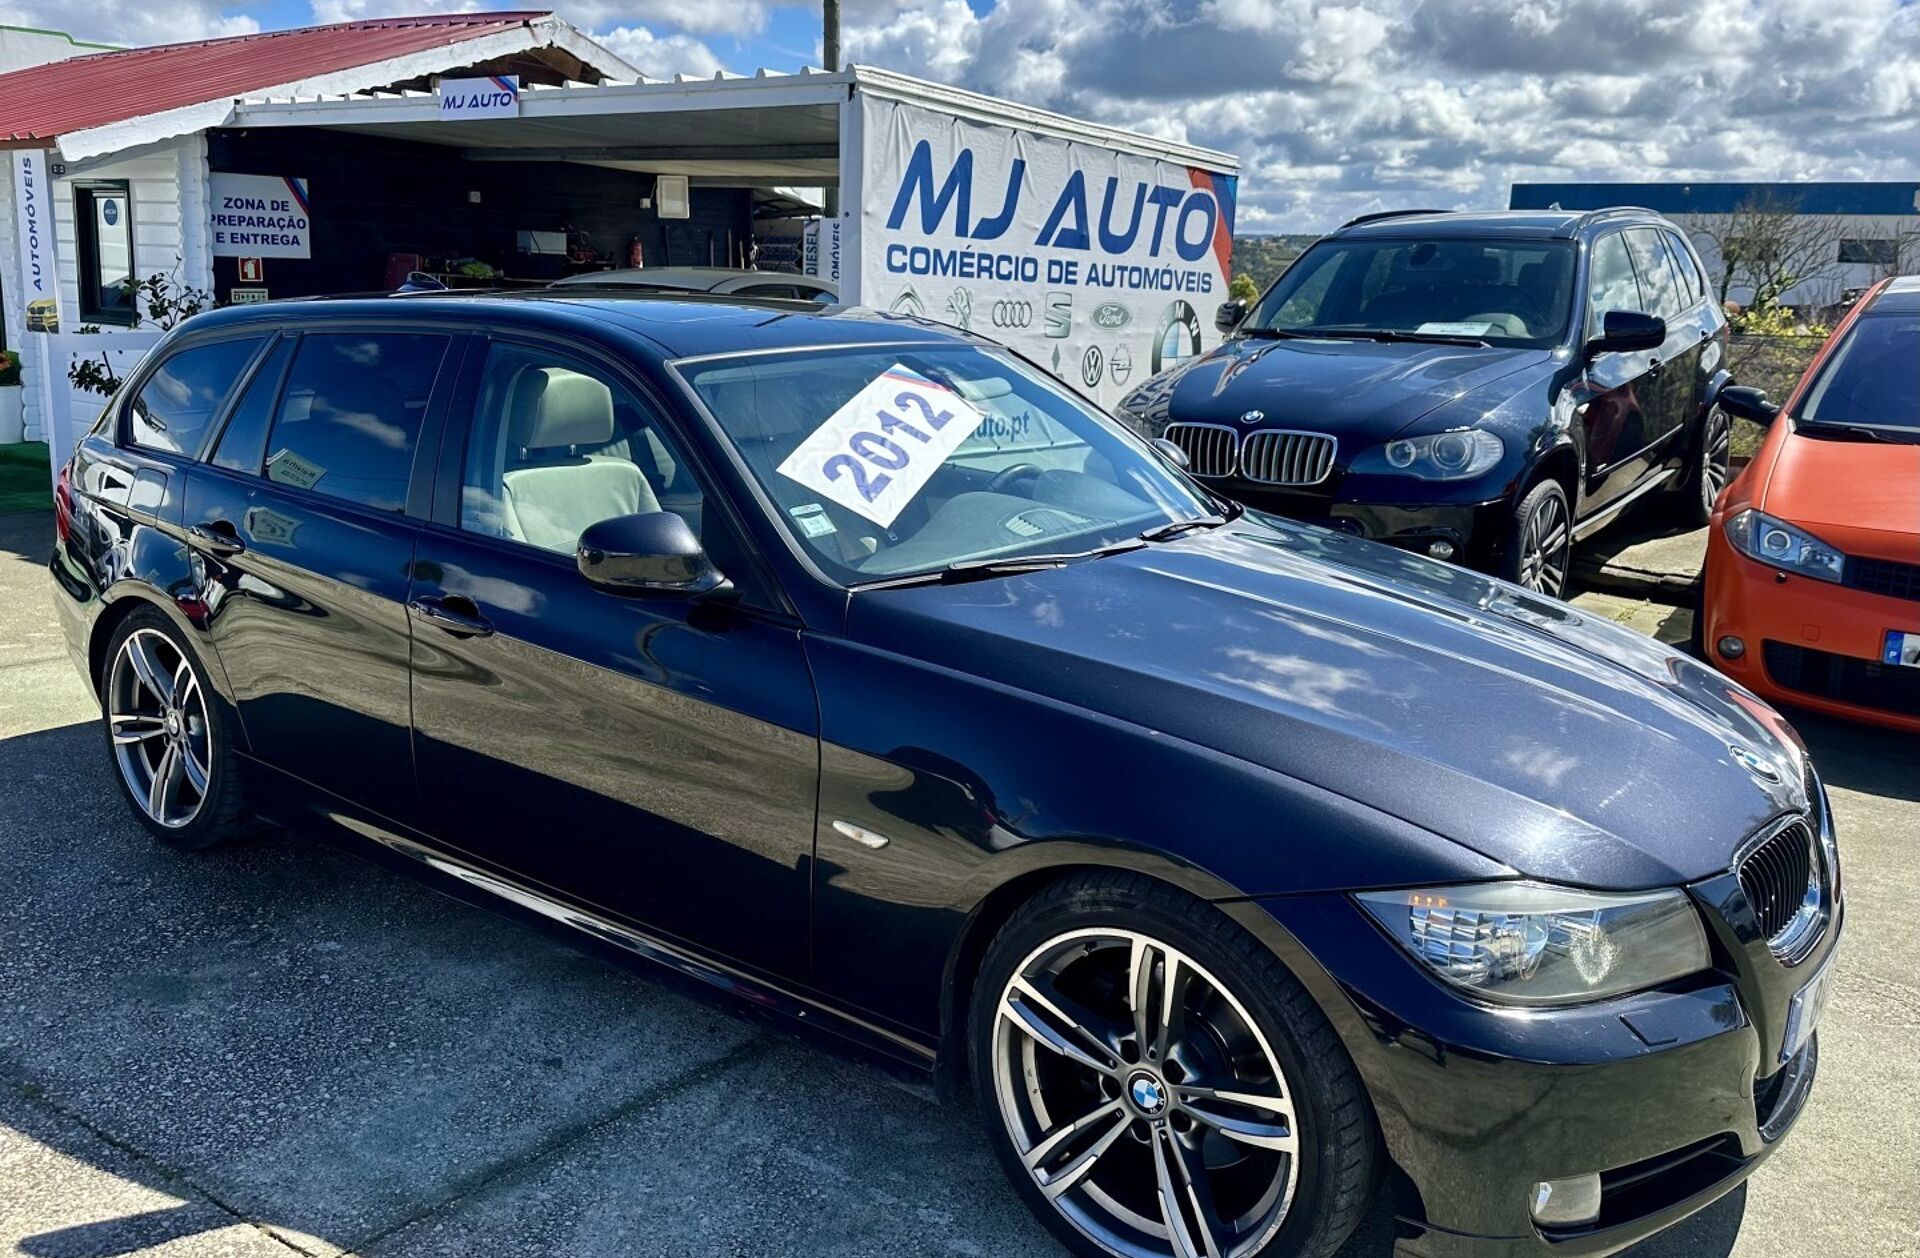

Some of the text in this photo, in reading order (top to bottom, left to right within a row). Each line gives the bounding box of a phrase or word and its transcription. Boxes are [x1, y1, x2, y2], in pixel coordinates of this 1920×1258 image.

[442, 92, 512, 110] MJ AUTO
[223, 196, 290, 212] ZONA DE
[885, 139, 1217, 262] MJ AUTO
[23, 157, 42, 291] AUTOMÓVEIS
[215, 232, 301, 246] E ENTREGA
[805, 233, 818, 275] DIESEL
[830, 222, 840, 282] OMÓVEIS
[886, 243, 1213, 294] COMÉRCIO DE AUTOMÓVEIS
[1099, 306, 1123, 324] Ford
[822, 391, 955, 503] 2012
[968, 411, 1030, 443] uto.pt
